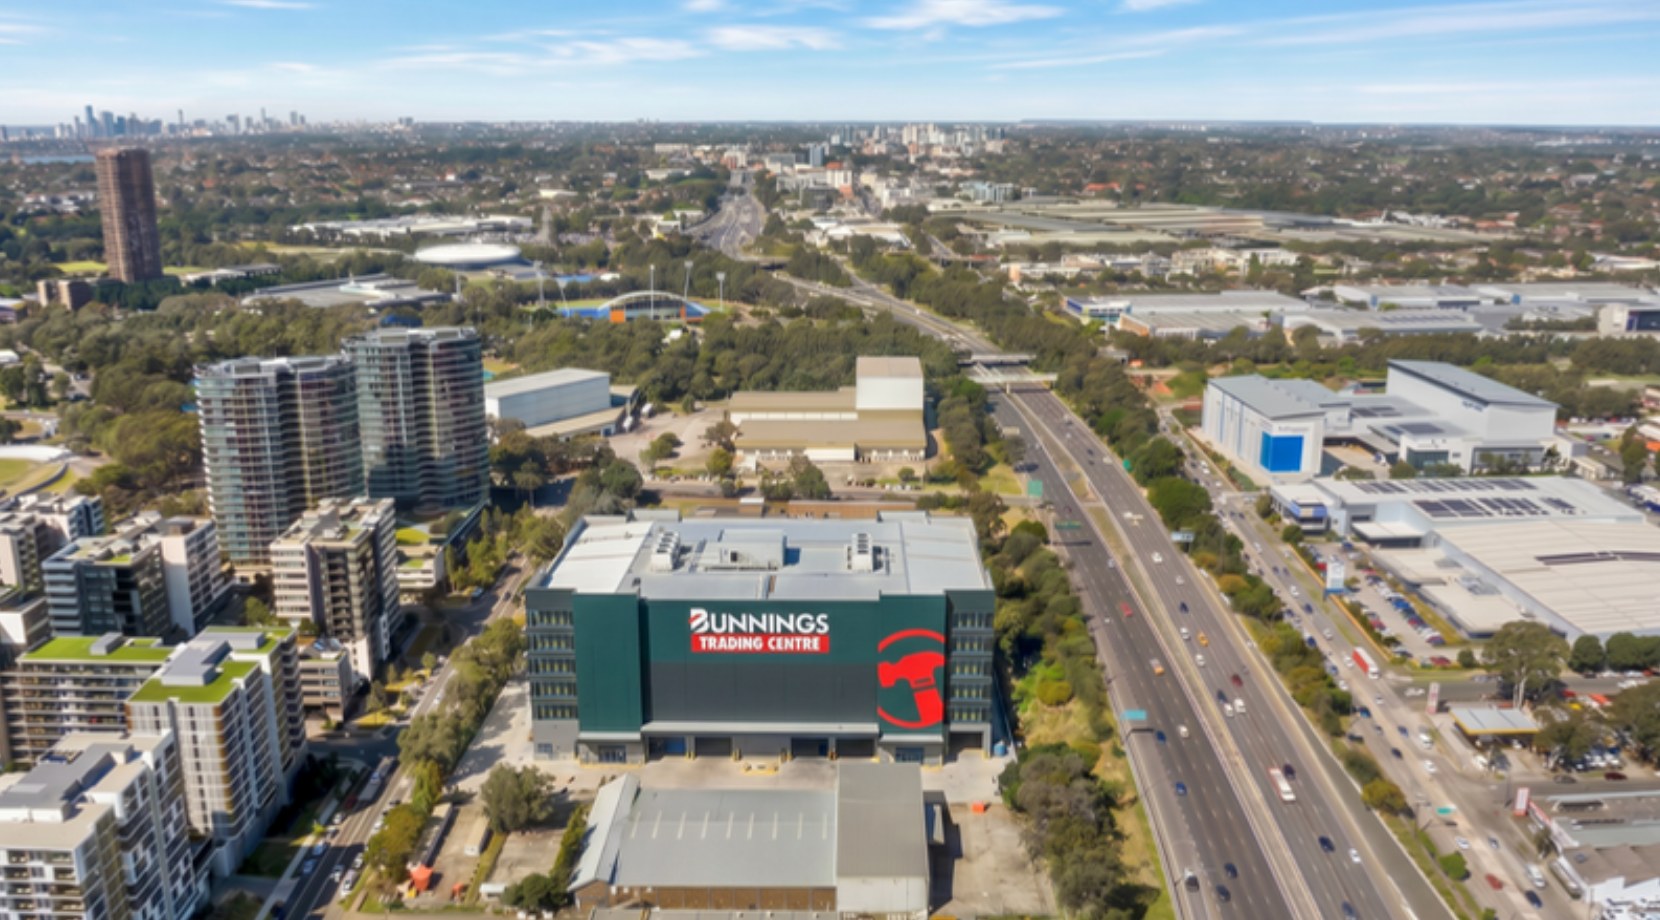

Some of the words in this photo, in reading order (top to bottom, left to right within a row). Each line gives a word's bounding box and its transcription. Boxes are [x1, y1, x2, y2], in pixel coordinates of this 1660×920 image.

[689, 607, 830, 634] BUNNINGS
[699, 636, 763, 650] TRADING
[767, 636, 820, 650] CENTRE
